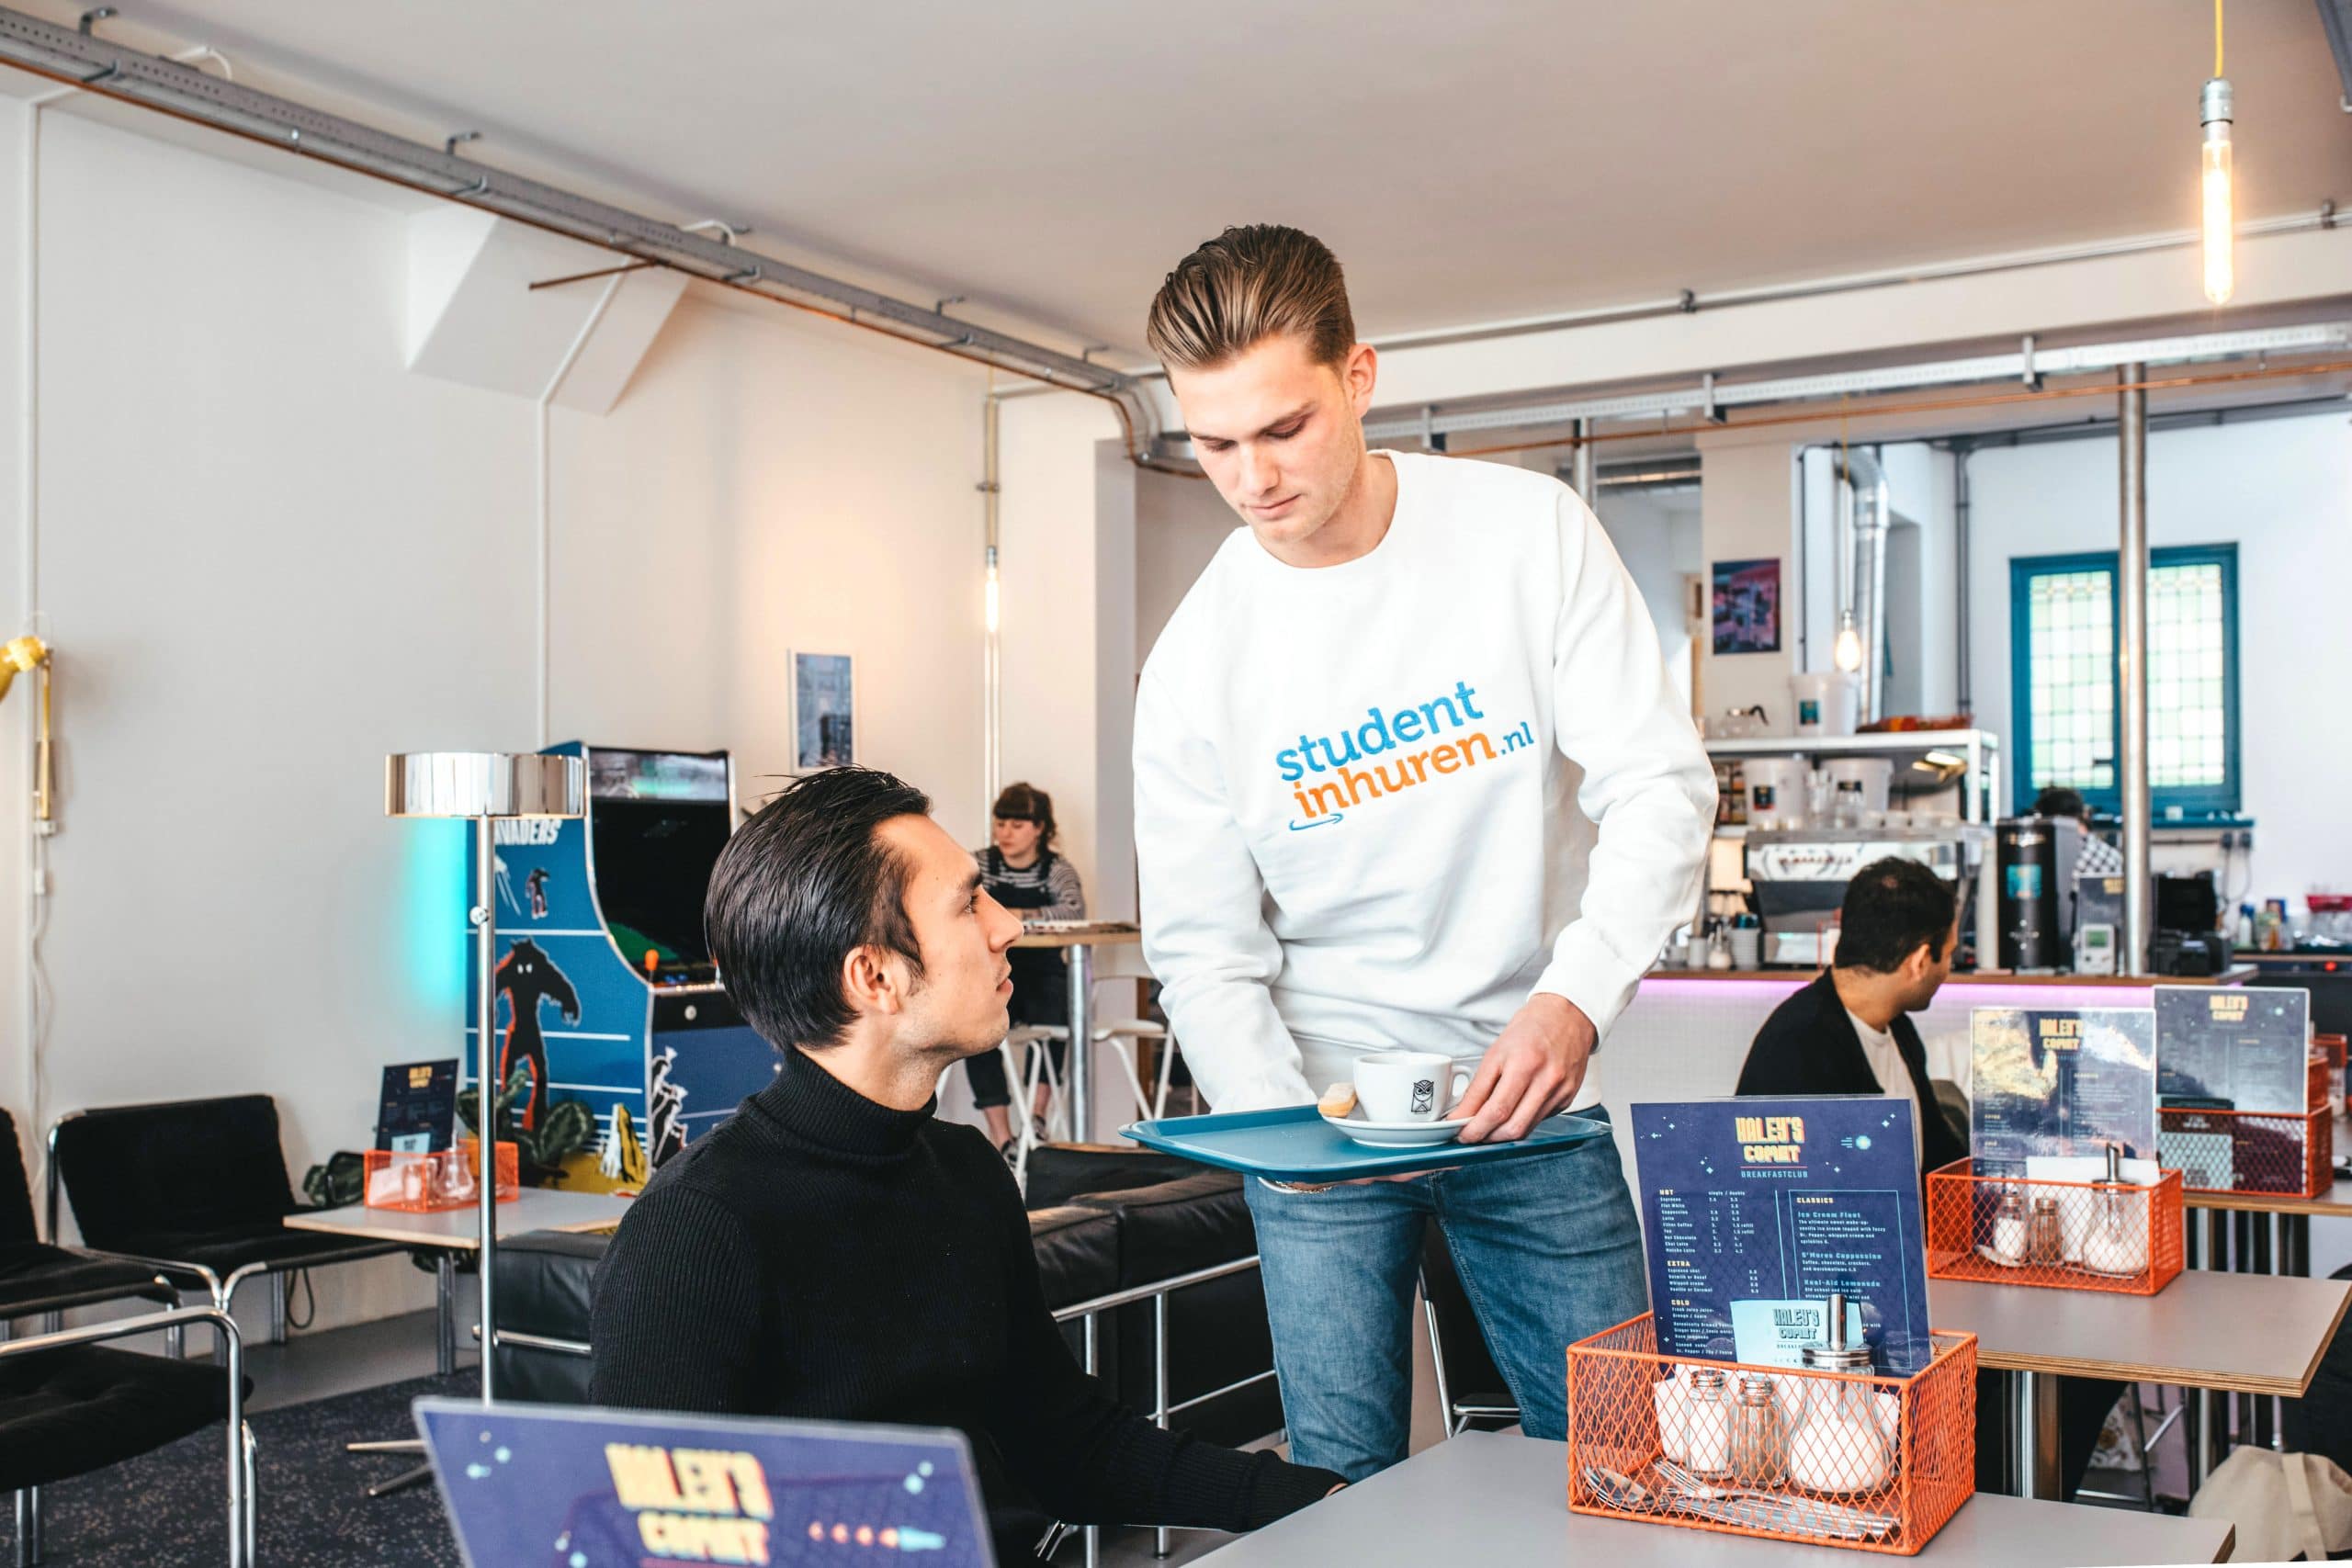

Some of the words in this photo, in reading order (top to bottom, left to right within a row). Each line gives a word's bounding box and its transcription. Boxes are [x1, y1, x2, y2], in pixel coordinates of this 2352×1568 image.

[1276, 681, 1484, 781] student
[1735, 1116, 1805, 1145] HALEY'S
[1744, 1145, 1801, 1163] COMET
[1772, 1308, 1820, 1327] HALEY'S
[1779, 1327, 1817, 1340] COMET
